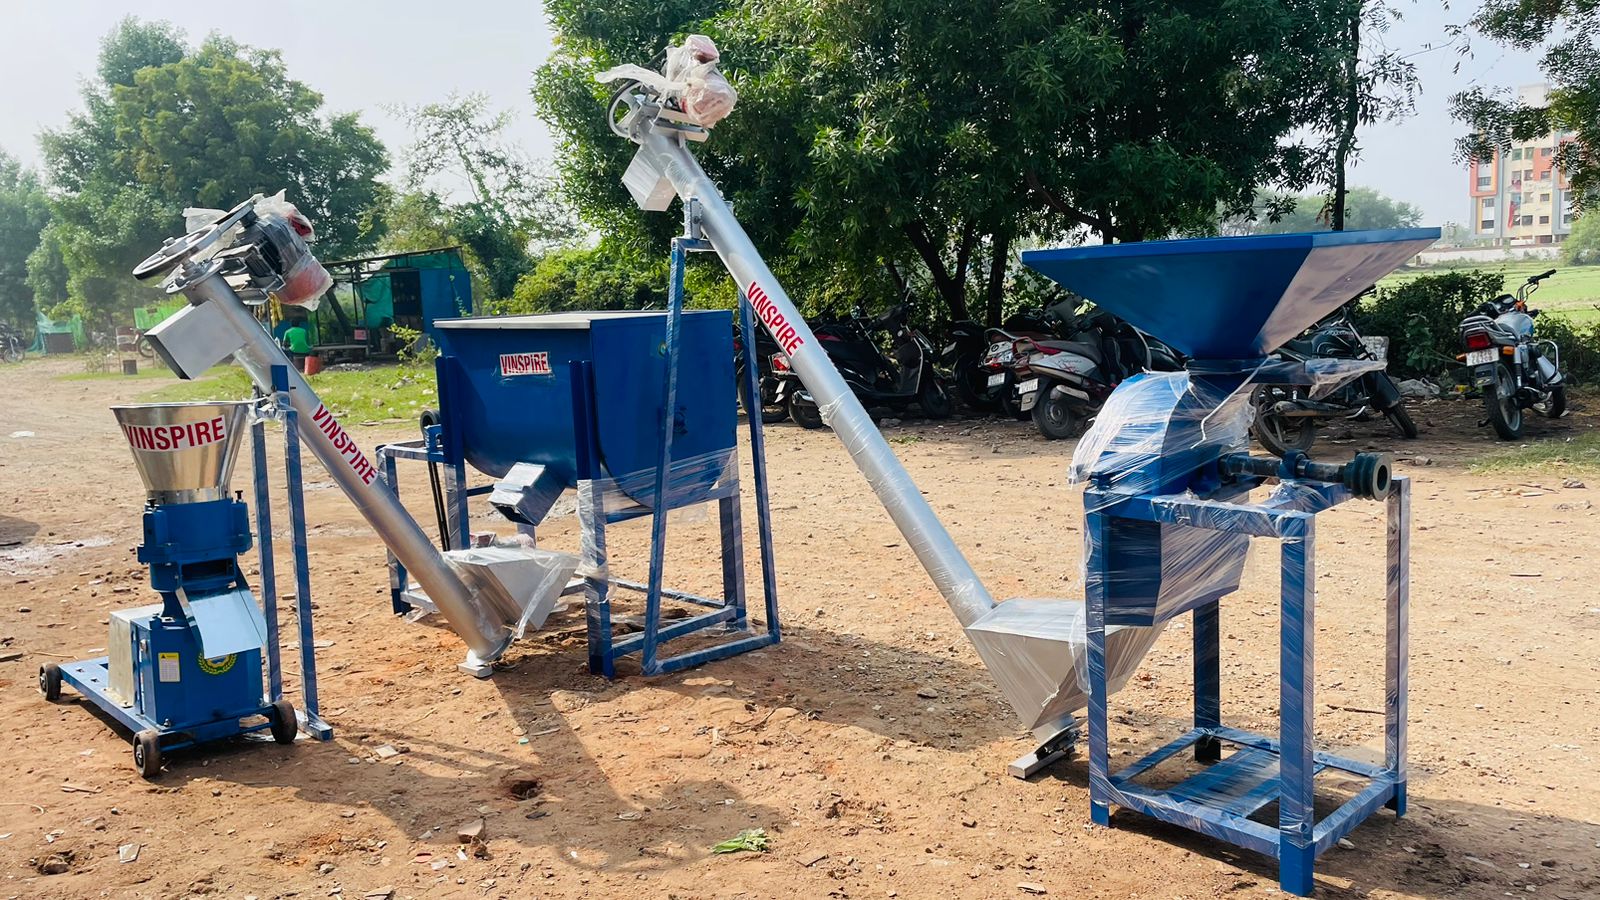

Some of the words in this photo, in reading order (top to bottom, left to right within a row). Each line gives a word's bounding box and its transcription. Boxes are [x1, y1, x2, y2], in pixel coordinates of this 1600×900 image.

[747, 281, 804, 356] VINSPIRE
[500, 353, 548, 374] VINSPIRE
[123, 417, 225, 450] VINSPIRE
[312, 403, 377, 485] VINSPIRE
